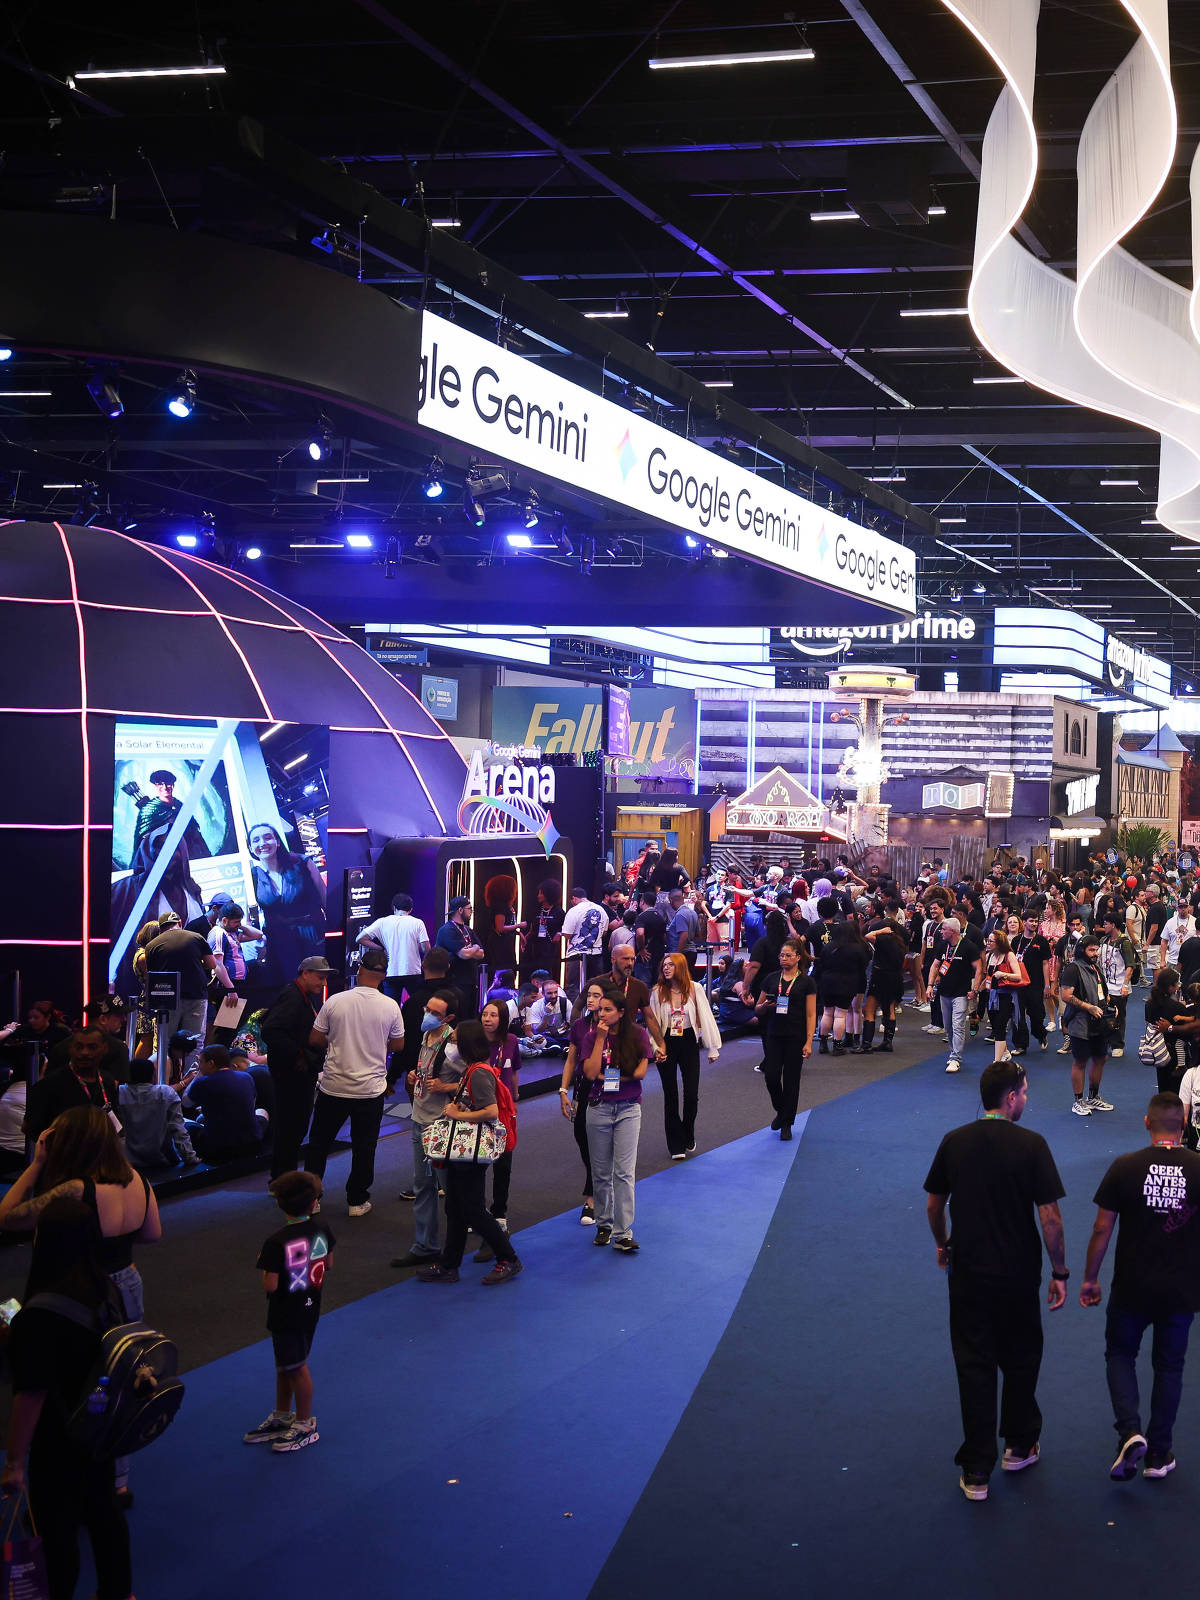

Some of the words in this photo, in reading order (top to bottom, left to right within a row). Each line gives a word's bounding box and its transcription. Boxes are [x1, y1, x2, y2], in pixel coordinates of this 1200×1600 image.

[472, 365, 588, 463] Gemini
[648, 447, 730, 527] Google
[736, 488, 800, 552] Gemini
[835, 533, 886, 591] Google
[892, 611, 976, 644] prime
[524, 703, 676, 766] Fallut
[125, 740, 151, 749] Solar
[156, 741, 204, 750] Elemental
[493, 743, 519, 760] Google
[519, 744, 541, 758] Gemini
[464, 748, 556, 803] Arena
[225, 866, 240, 877] 03
[1149, 1164, 1183, 1177] GEEK
[1144, 1174, 1187, 1188] ANTES
[1143, 1185, 1161, 1196] DE
[1162, 1186, 1187, 1199] SER
[1146, 1196, 1183, 1209] HYPE.
